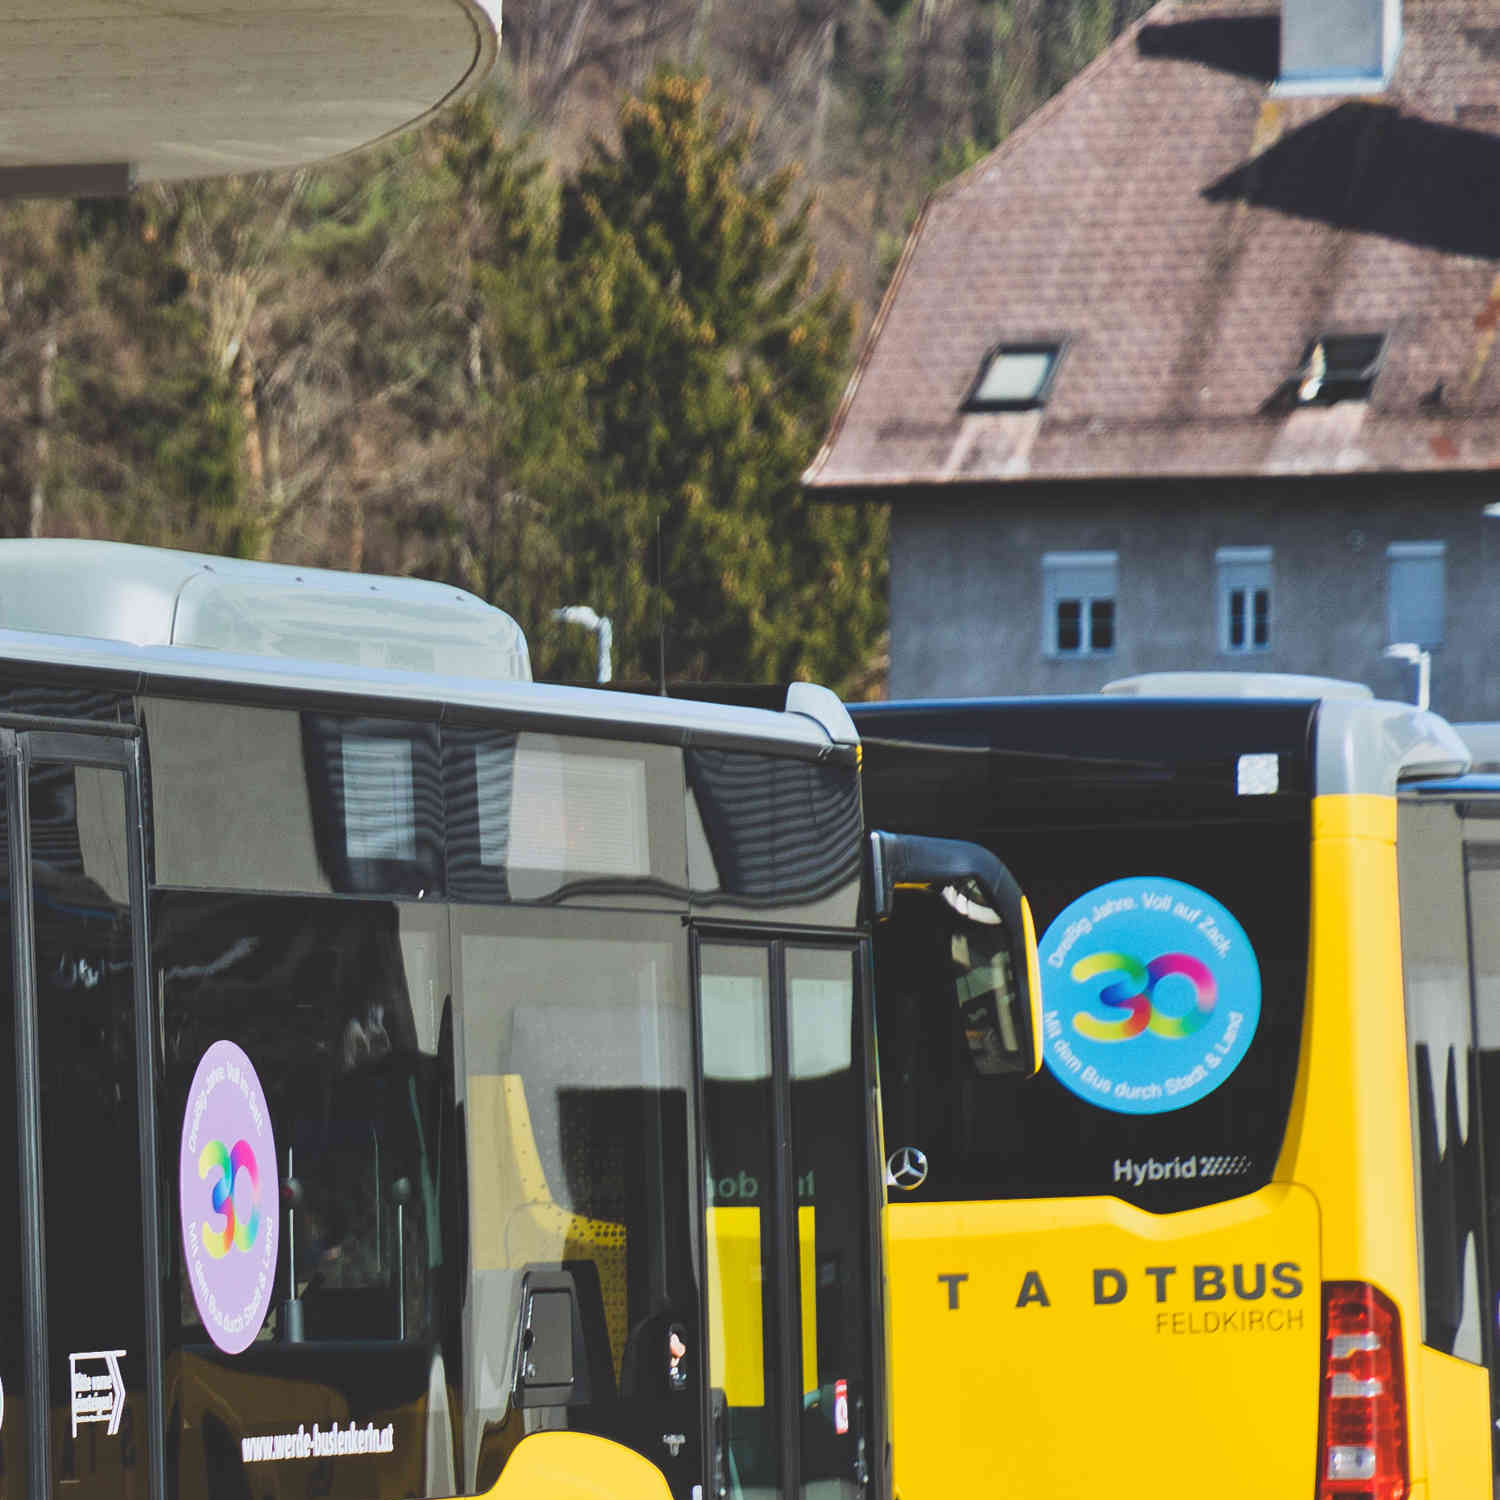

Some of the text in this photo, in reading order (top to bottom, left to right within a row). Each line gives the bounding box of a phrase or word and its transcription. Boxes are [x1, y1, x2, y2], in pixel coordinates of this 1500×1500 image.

[1141, 891, 1172, 912] Voll
[1172, 902, 1203, 923] auf
[1072, 951, 1217, 1043] 30
[1044, 1009, 1062, 1039] Mit
[1054, 1039, 1083, 1073] dem
[1081, 1066, 1112, 1093] Bus
[1115, 1081, 1162, 1100] durch
[1165, 1064, 1208, 1095] Stadt
[1215, 1010, 1243, 1055] Land
[1114, 1157, 1197, 1186] Hybrid
[198, 1139, 262, 1260] 30
[938, 1261, 1304, 1310] TADTBUS
[1156, 1308, 1304, 1335] FELDKIRCH
